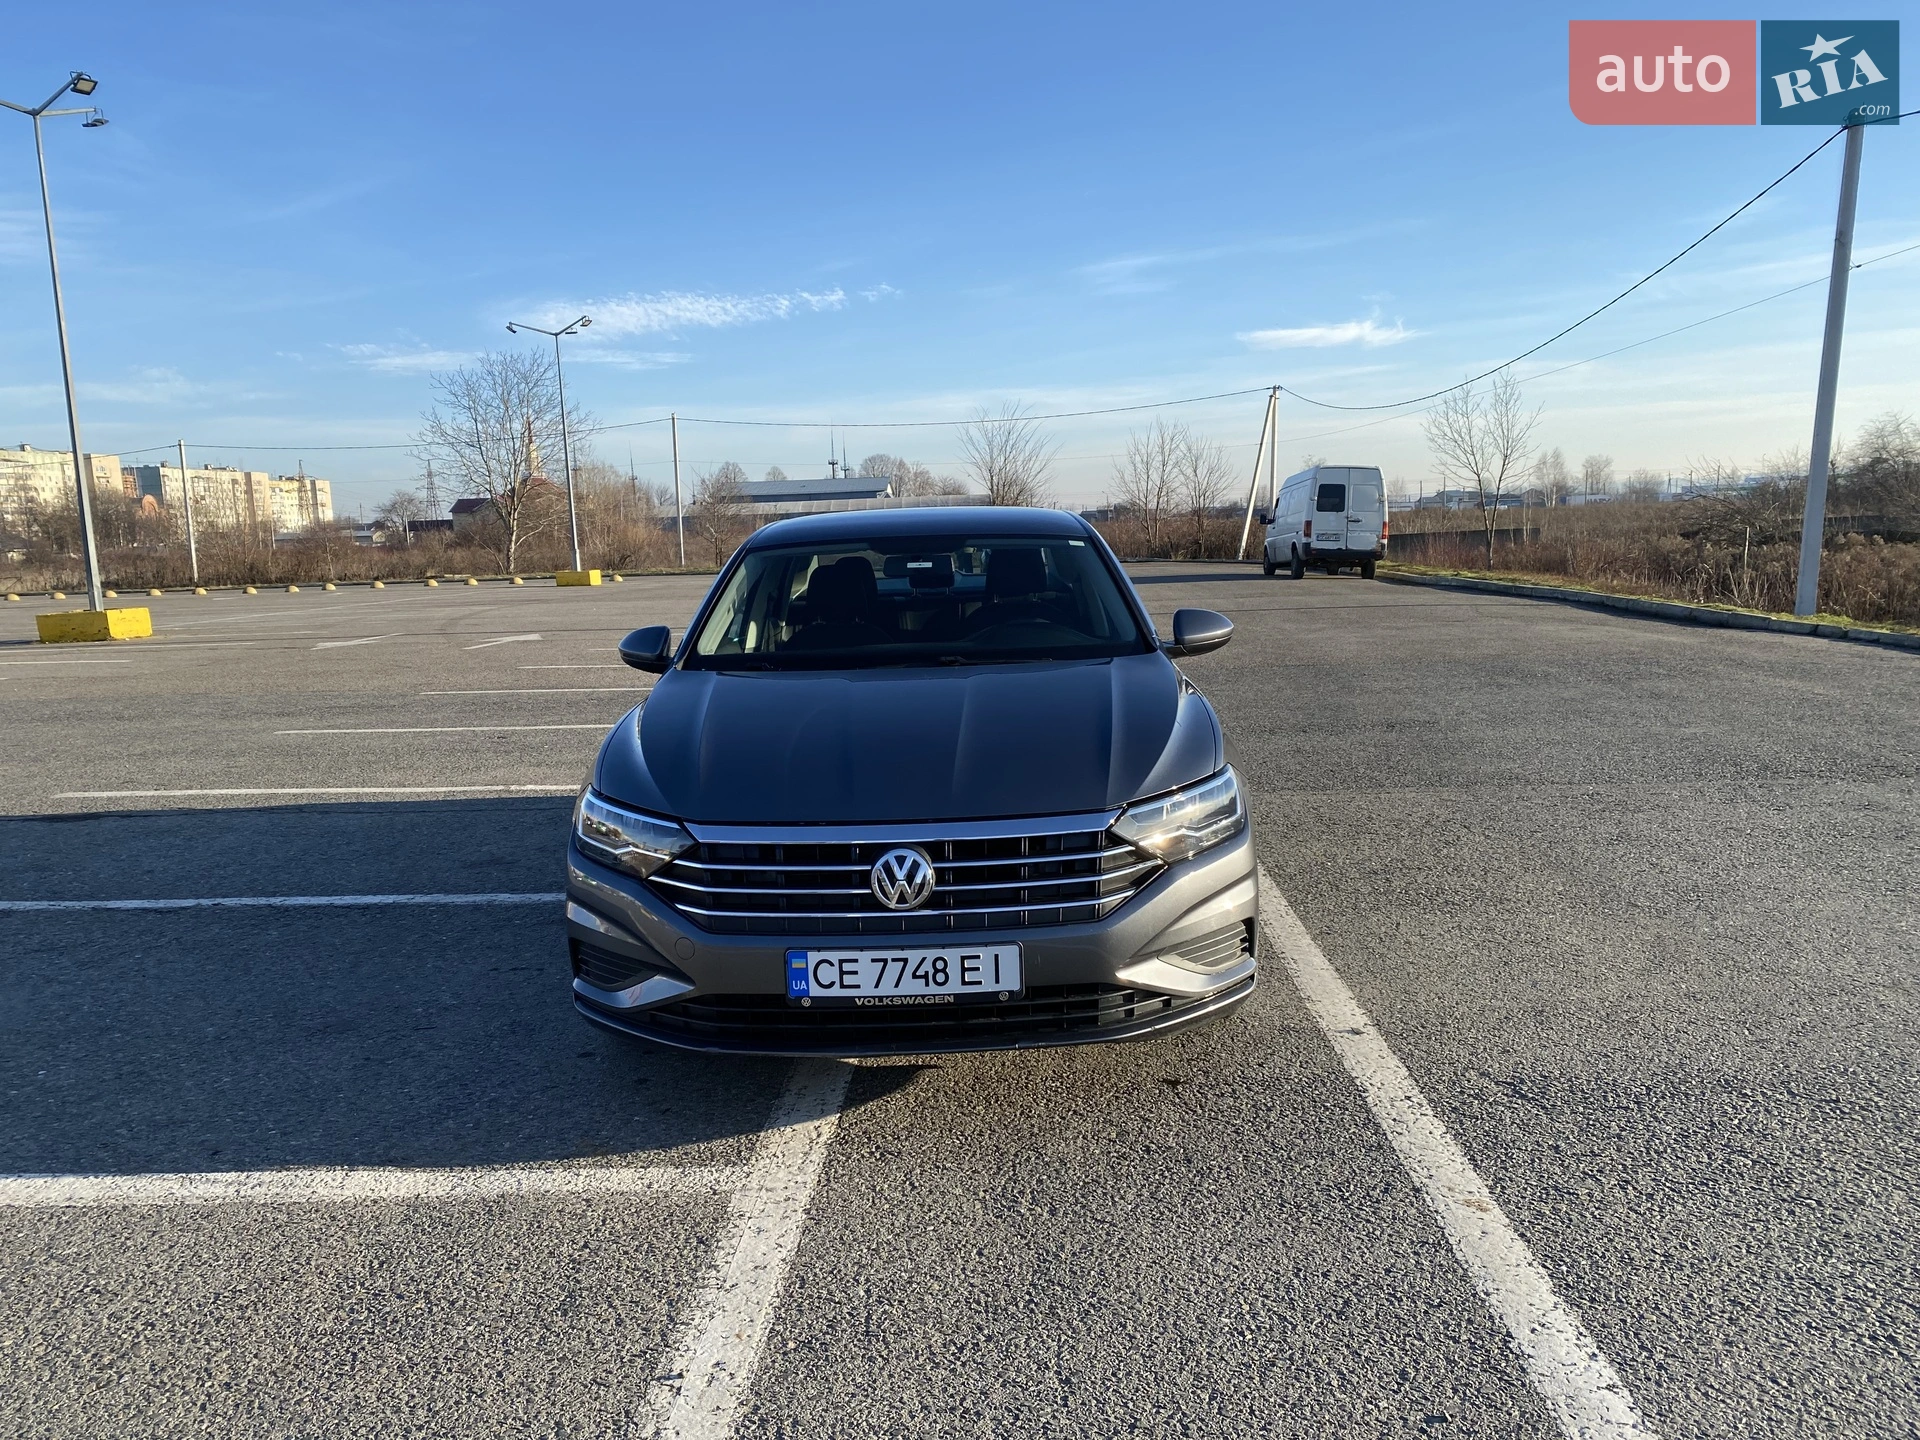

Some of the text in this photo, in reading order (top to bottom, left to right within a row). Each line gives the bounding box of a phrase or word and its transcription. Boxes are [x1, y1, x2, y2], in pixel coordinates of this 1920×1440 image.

[812, 953, 1000, 989] CE 7748 EI
[792, 980, 808, 990] UA
[854, 995, 954, 1006] VOLKSWAGEN
